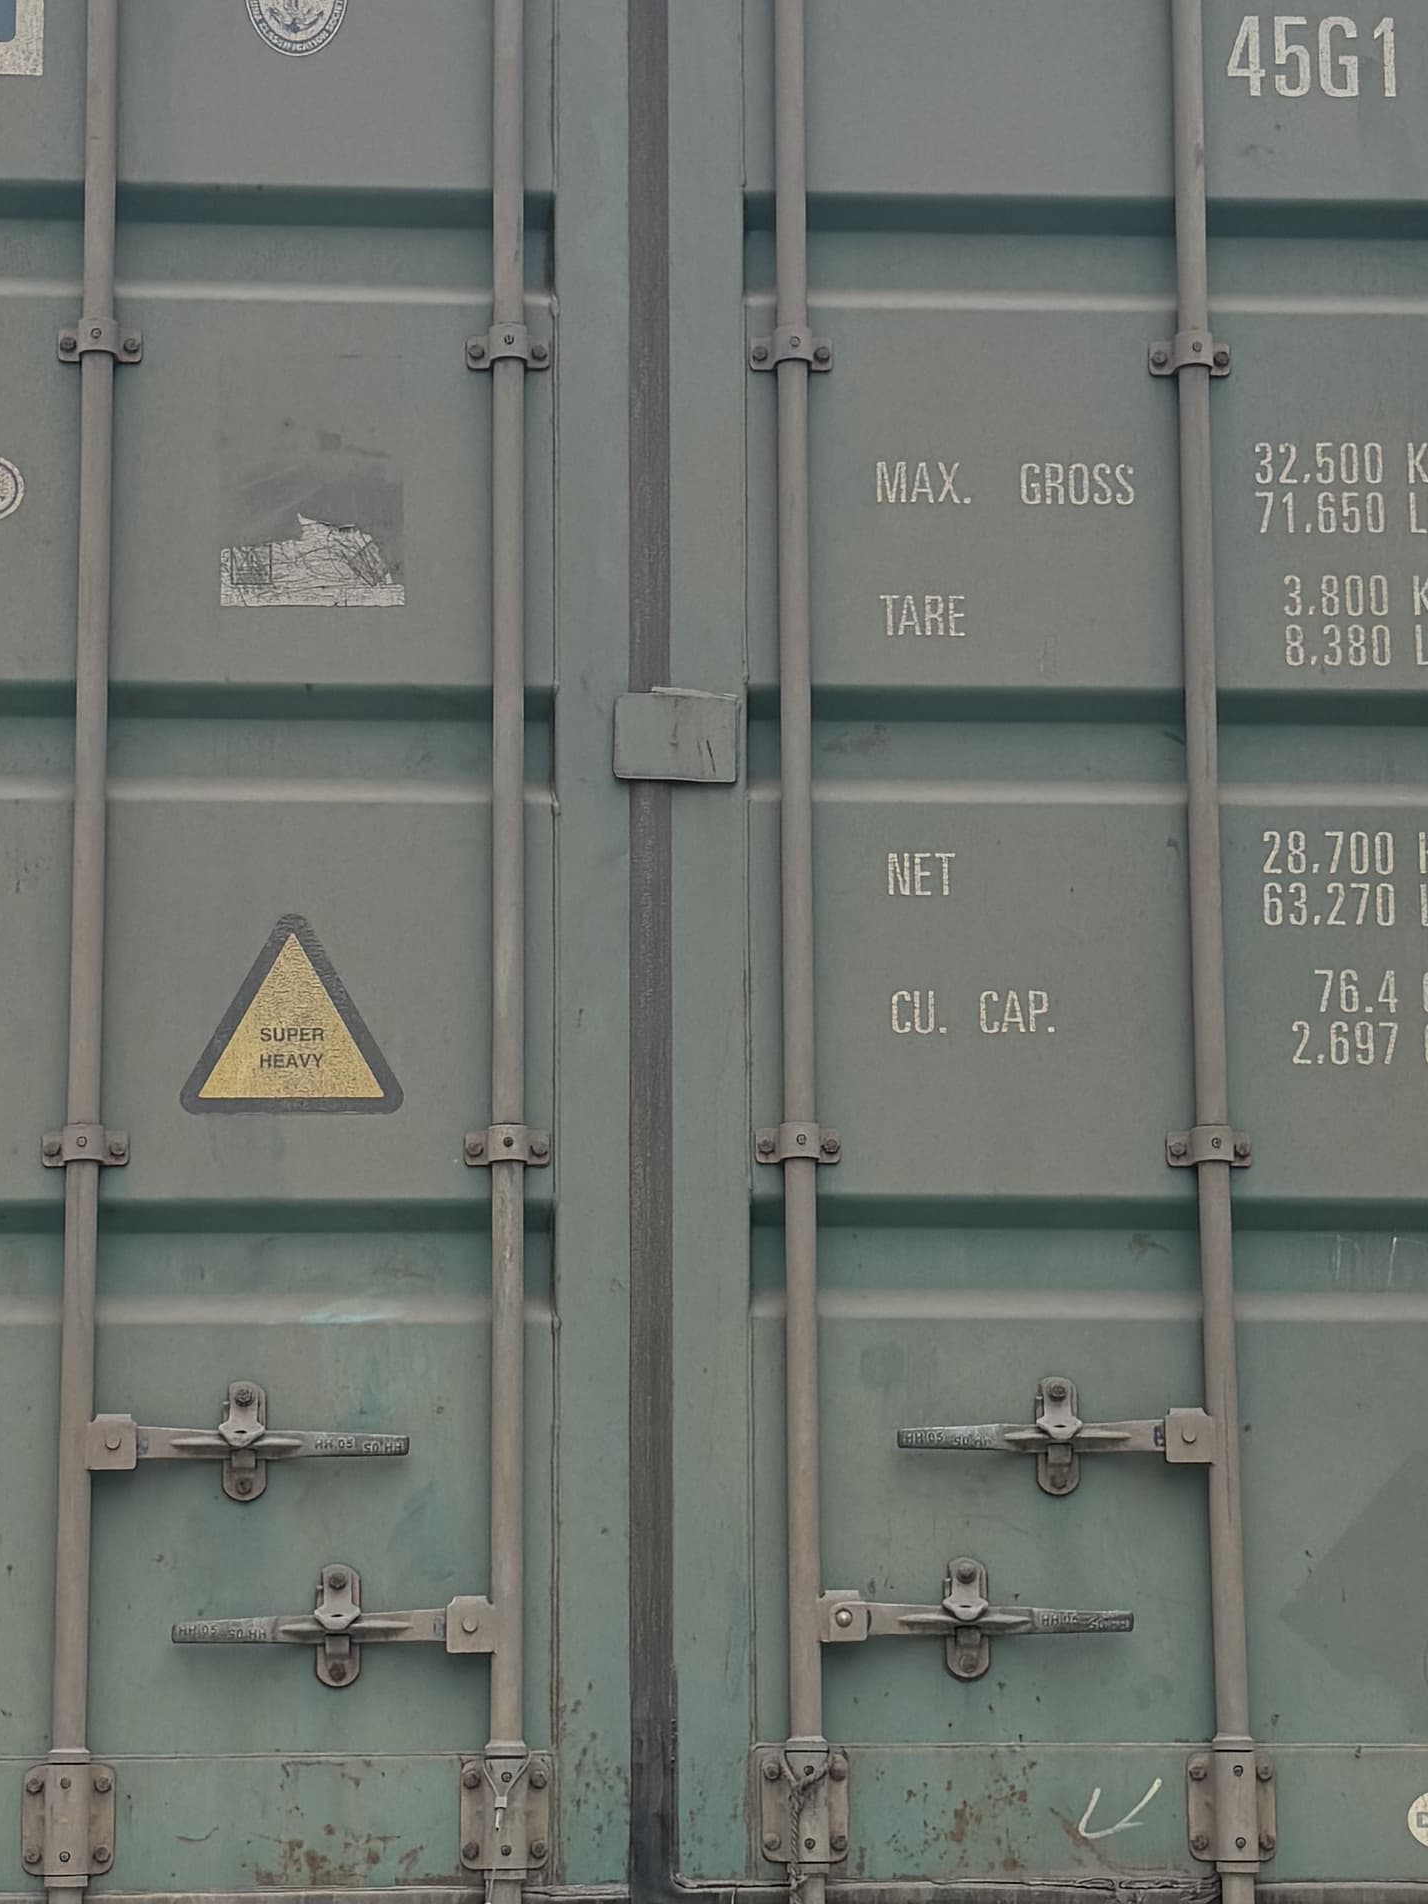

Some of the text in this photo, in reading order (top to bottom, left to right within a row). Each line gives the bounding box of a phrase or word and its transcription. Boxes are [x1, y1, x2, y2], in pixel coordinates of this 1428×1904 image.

[1227, 16, 1398, 97] 45G1
[876, 462, 972, 504] MAX.
[1021, 463, 1134, 505] GROSS
[1254, 442, 1383, 484] 32,500
[1254, 492, 1385, 534] 71,650
[879, 595, 966, 637] TARE
[1285, 625, 1391, 666] 8,380
[887, 853, 956, 896] NET
[1262, 832, 1394, 875] 28,700
[1263, 882, 1396, 926] 63,270
[890, 990, 948, 1034] CU.
[979, 990, 1056, 1034] CAP.
[1314, 970, 1399, 1014] 76.4
[260, 1027, 324, 1042] SUPER
[260, 1054, 323, 1069] HEAVY
